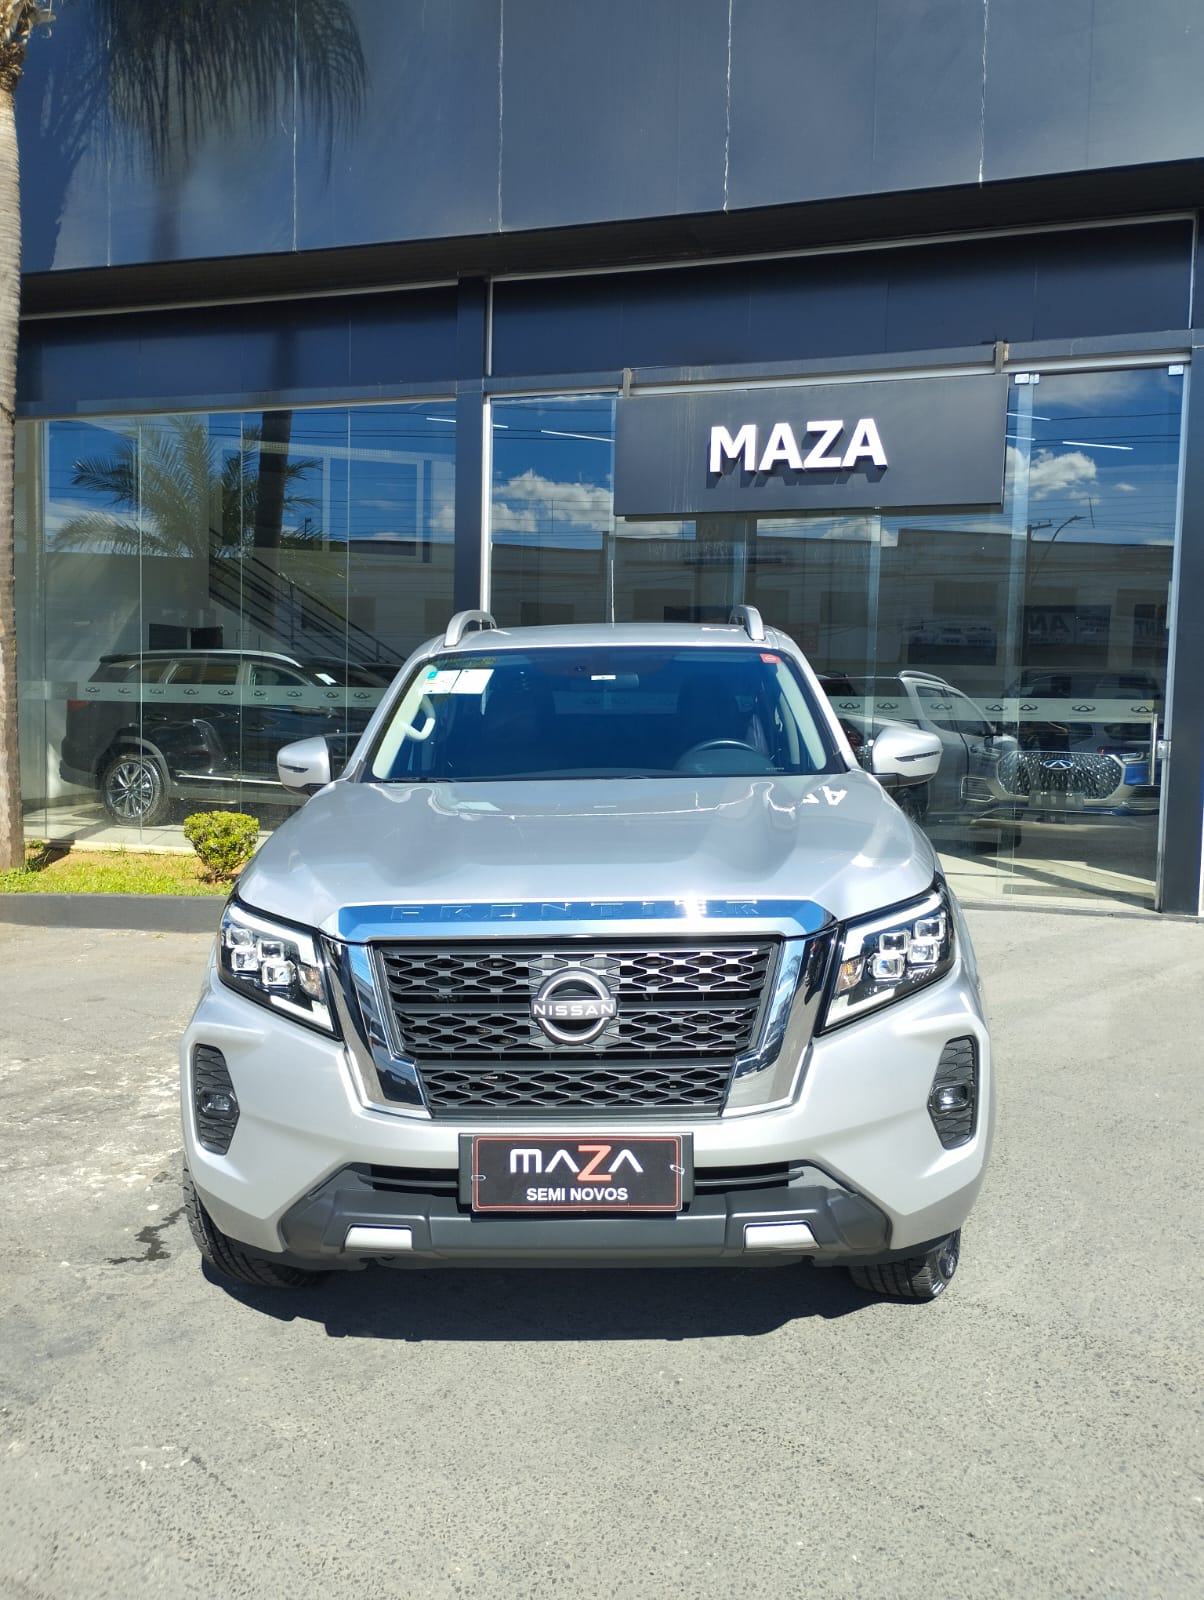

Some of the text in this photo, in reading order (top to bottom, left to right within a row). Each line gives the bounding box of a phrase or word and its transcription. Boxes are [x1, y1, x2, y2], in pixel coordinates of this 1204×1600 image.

[709, 418, 888, 473] MAZA
[533, 1003, 614, 1016] NISSAN
[509, 1145, 644, 1182] MAZA
[526, 1187, 629, 1201] SEMI NOVOS
